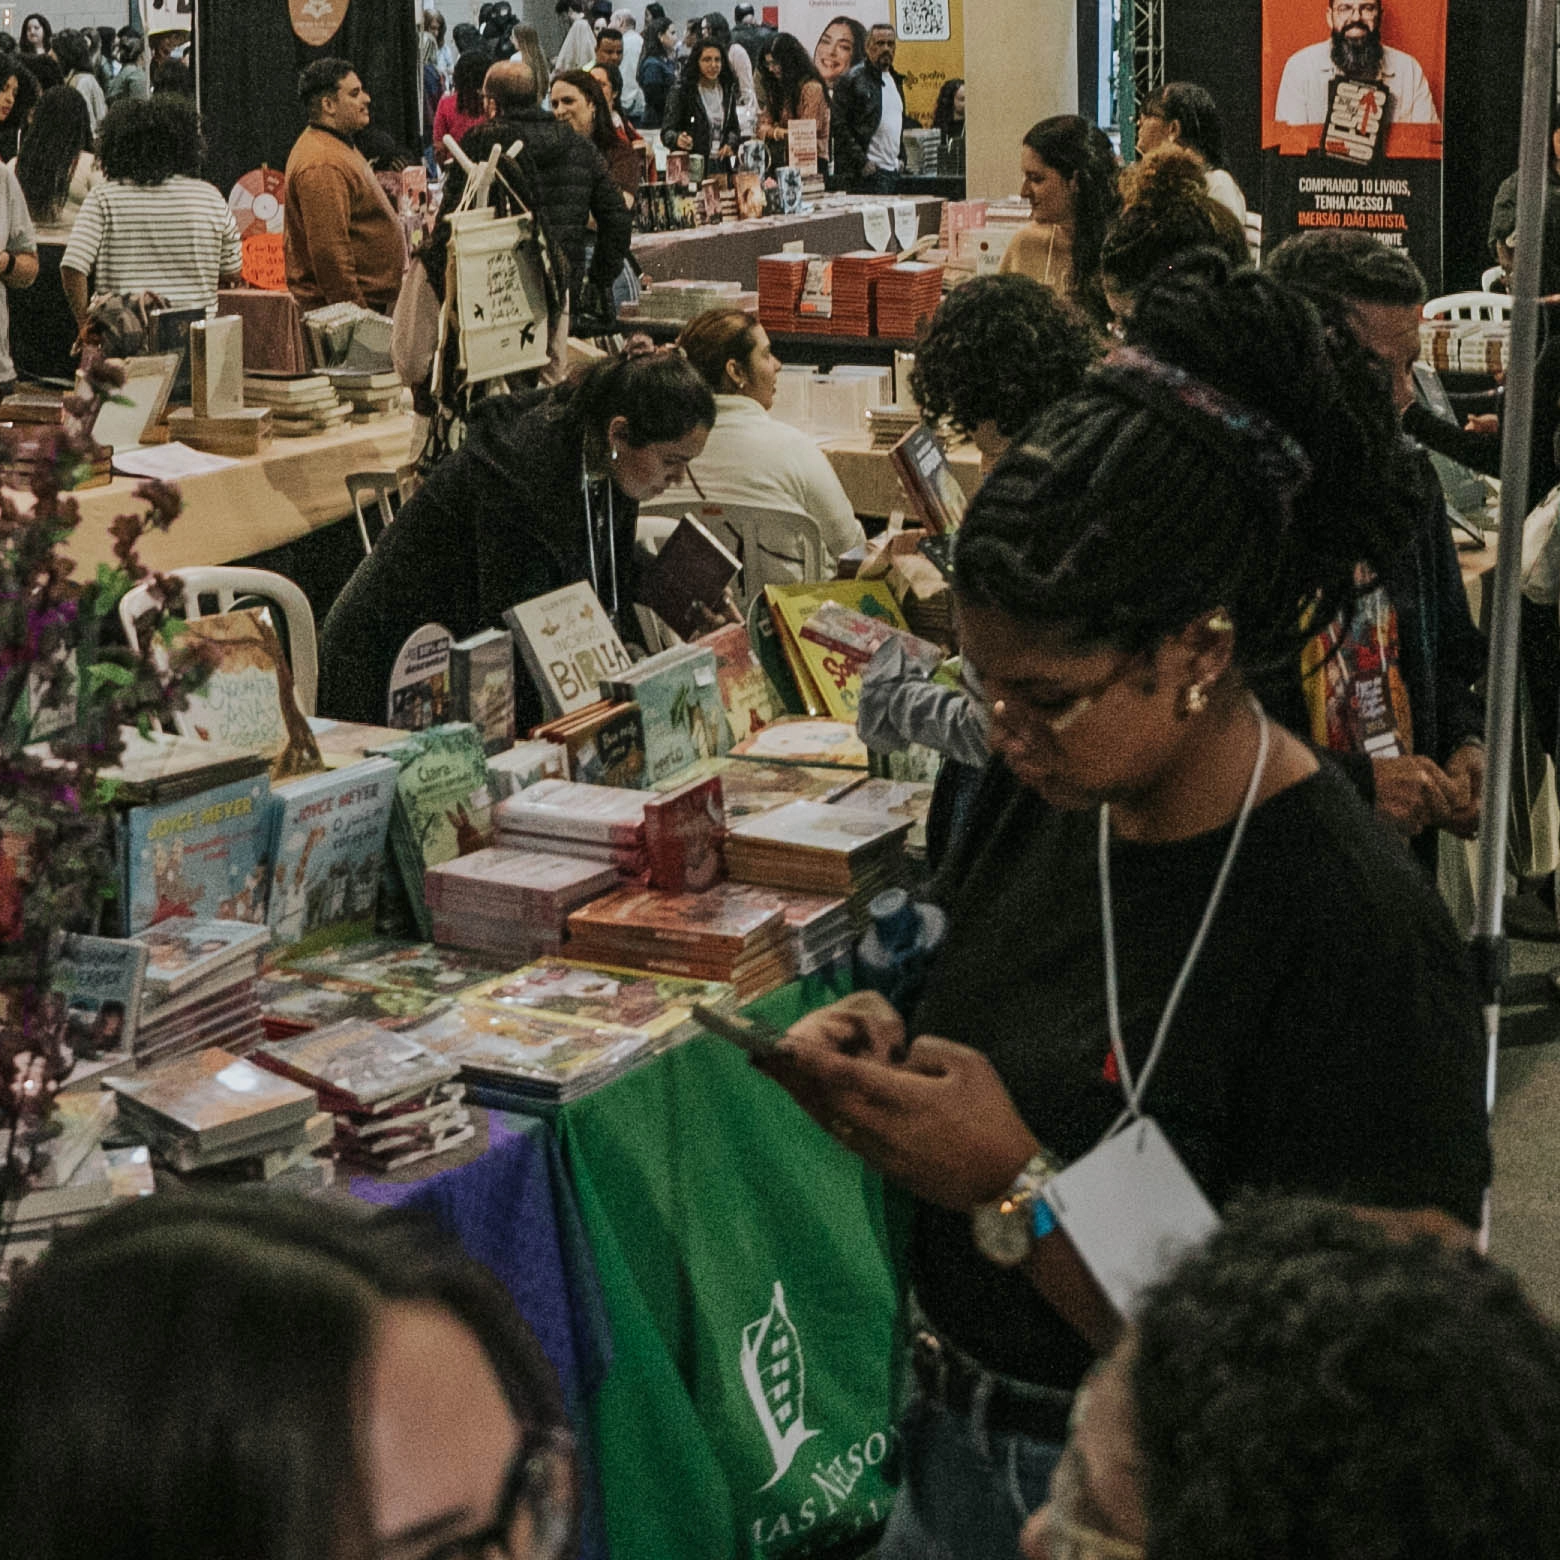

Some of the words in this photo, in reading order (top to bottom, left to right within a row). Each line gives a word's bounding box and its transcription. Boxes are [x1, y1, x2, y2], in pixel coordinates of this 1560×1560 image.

[1298, 177, 1359, 193] COMPRANDO
[1361, 179, 1374, 194] 10
[1374, 179, 1411, 197] LIVROS,
[1314, 194, 1346, 211] TENHA
[1347, 195, 1384, 212] ACESSO
[1385, 196, 1393, 212] A
[1298, 210, 1341, 227] IMERSÃO
[1342, 211, 1366, 228] JOÃO
[339, 781, 380, 808] MEYER
[146, 811, 195, 840] JOYCE
[200, 796, 252, 824] MEYER
[810, 1429, 889, 1516] NELSO
